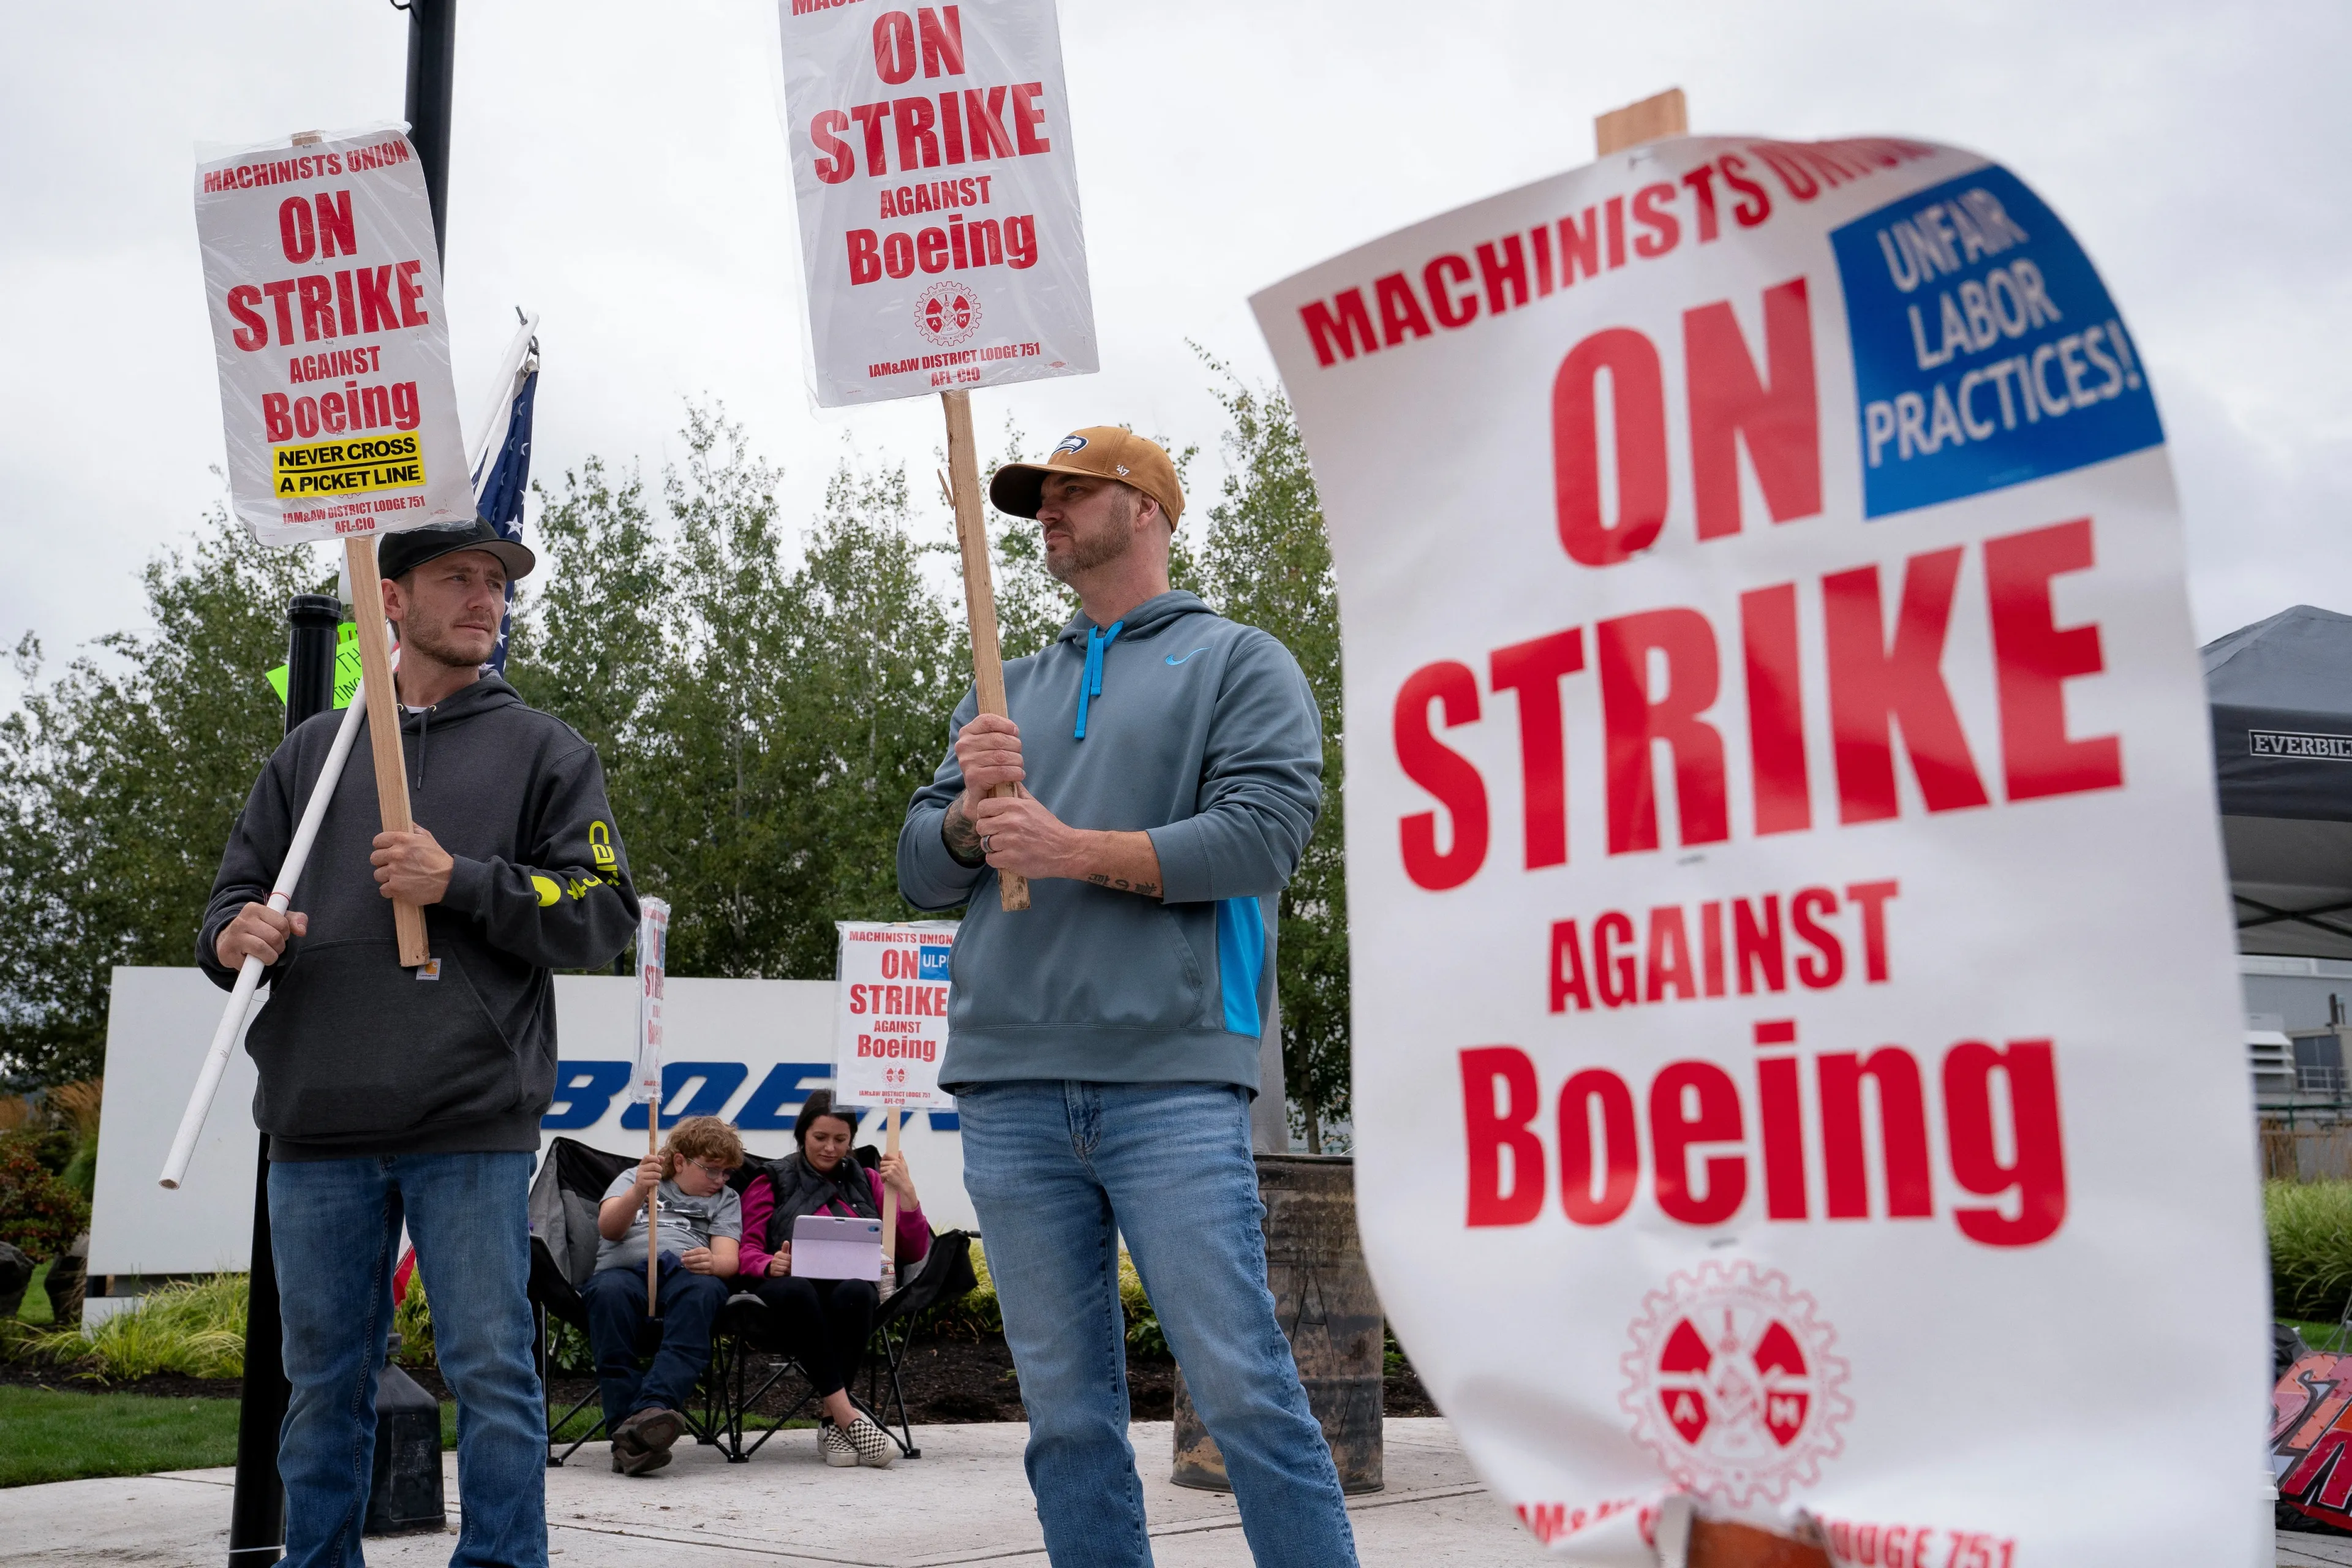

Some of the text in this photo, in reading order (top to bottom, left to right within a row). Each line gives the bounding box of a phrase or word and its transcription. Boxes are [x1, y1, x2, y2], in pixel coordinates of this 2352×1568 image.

[872, 5, 965, 85] ON
[810, 81, 1050, 184] STRIKE
[204, 140, 410, 193] MACHINISTS UNION
[880, 175, 992, 219] AGAINST
[279, 190, 358, 265] ON
[845, 213, 1038, 286] Boeing
[1297, 154, 1773, 370] MACHINISTS
[227, 259, 429, 352] STRIKE
[1907, 257, 2063, 371] LABOR
[289, 345, 381, 384] AGAINST
[869, 342, 1041, 378] IAM&AW DISTRICT LODGE 751
[931, 367, 980, 387] AFL-CIO
[262, 380, 421, 443] Boeing
[1550, 276, 1823, 568] ON
[1864, 318, 2143, 468] PRACTICES!
[279, 437, 417, 467] NEVER CROSS
[280, 464, 421, 492] A PICKET LINE
[282, 495, 426, 524] IAM&AW DISTRICT LODGE 751
[335, 517, 375, 533] AFL-CIO
[1392, 517, 2125, 894] STRIKE
[849, 931, 953, 944] MACHINISTS UNION
[881, 949, 919, 980] ON
[1547, 878, 1900, 1016] AGAINST
[850, 984, 948, 1017] STRIKE
[873, 1020, 922, 1033] AGAINST
[857, 1034, 937, 1063] Boeing
[541, 1061, 961, 1130] BOE
[1458, 1017, 2070, 1248] Boeing
